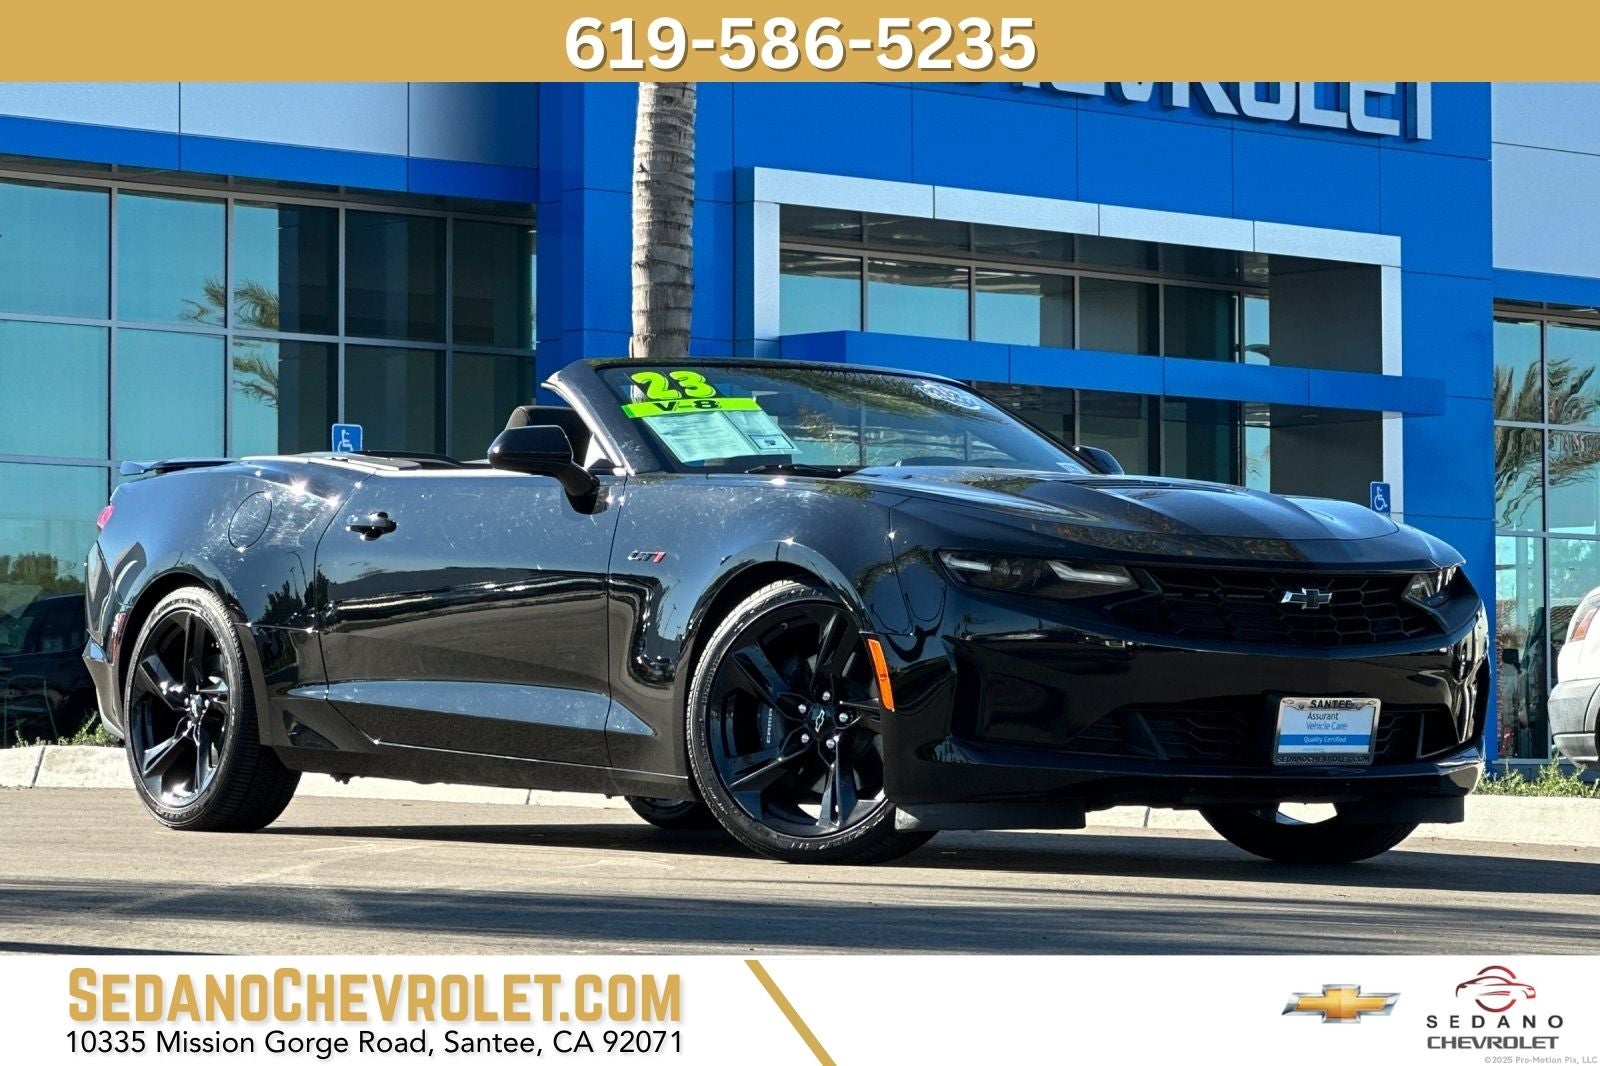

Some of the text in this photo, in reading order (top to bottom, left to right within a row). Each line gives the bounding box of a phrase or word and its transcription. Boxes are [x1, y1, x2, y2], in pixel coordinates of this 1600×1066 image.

[630, 369, 717, 400] 23
[652, 399, 720, 412] V-8
[1309, 699, 1353, 709] SANTEE
[1306, 711, 1339, 721] Assurant
[1306, 721, 1348, 731] Vehicle Care
